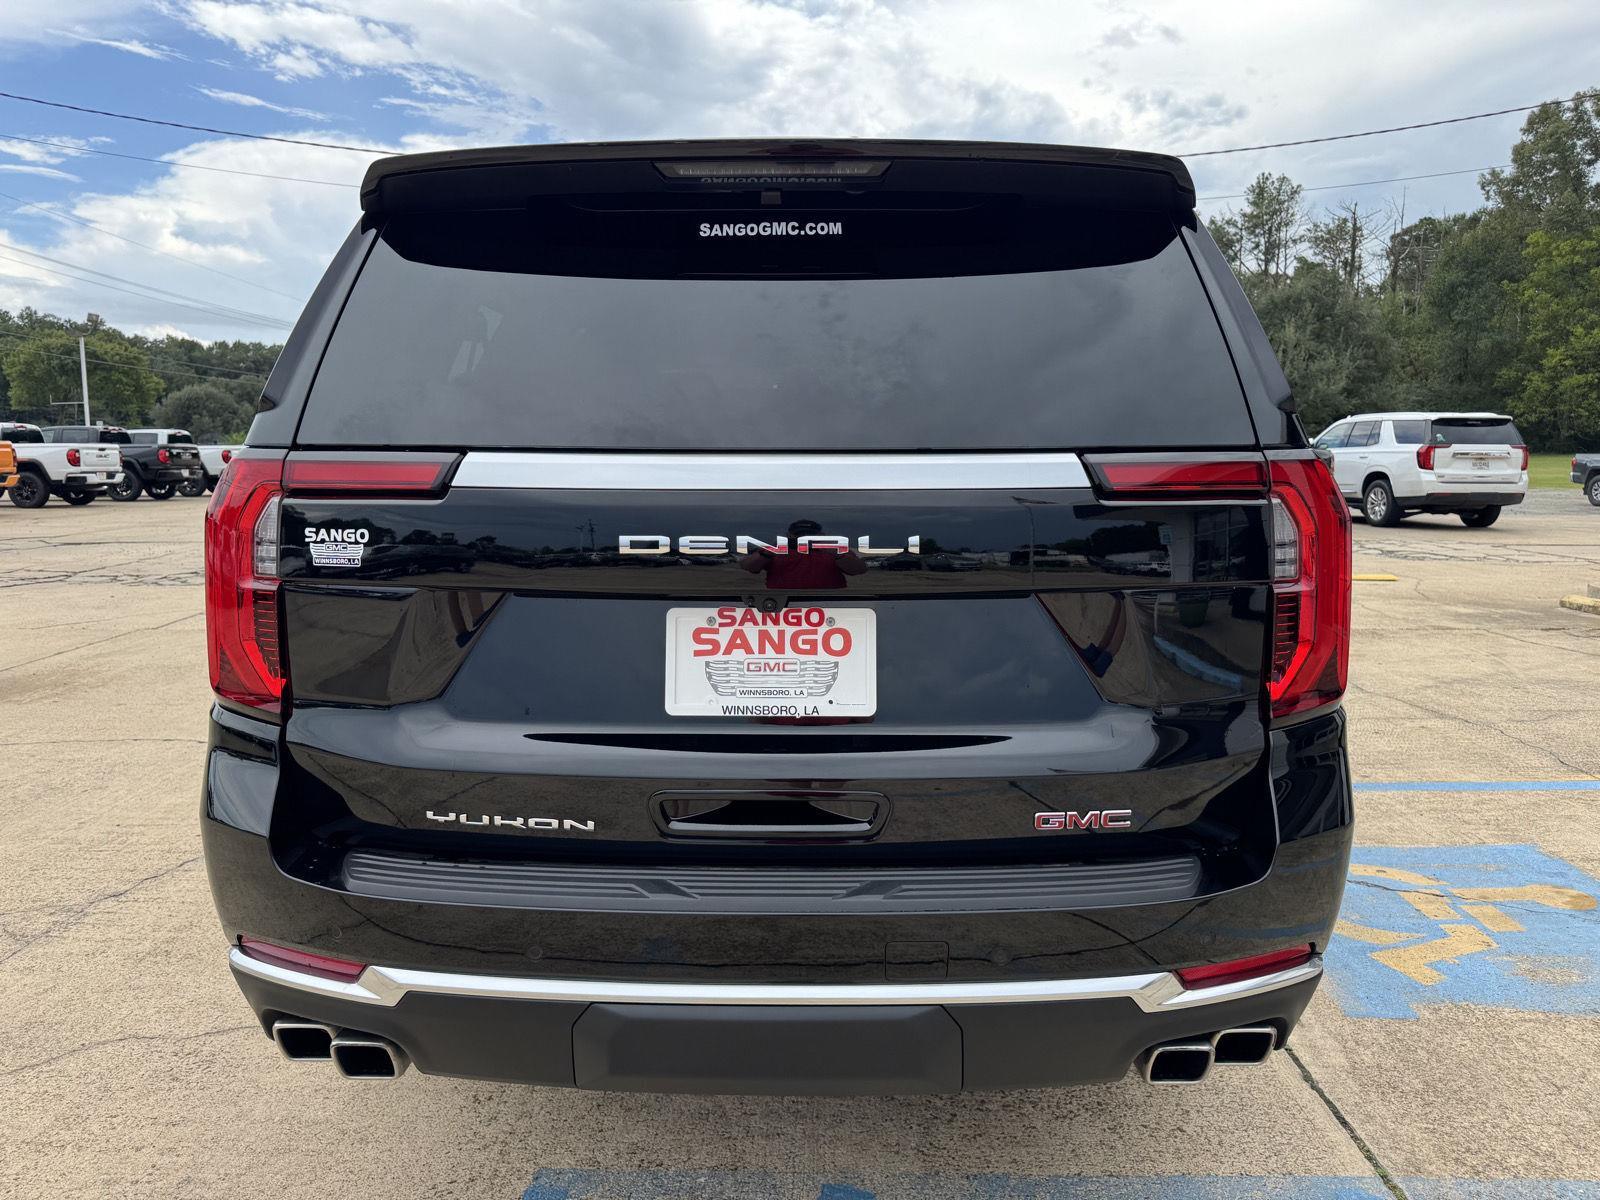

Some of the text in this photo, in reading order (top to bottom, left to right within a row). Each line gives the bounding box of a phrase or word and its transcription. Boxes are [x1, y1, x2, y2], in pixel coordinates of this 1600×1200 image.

[304, 527, 370, 543] SANGO
[618, 535, 920, 555] DENALI
[717, 607, 826, 628] SANGO
[692, 627, 853, 658] SANGO
[746, 661, 798, 673] GMC
[738, 689, 792, 697] WINNSBORO,
[721, 705, 820, 717] WINNSBORO, LA
[426, 810, 595, 832] YUKON
[1034, 809, 1132, 829] GMC
